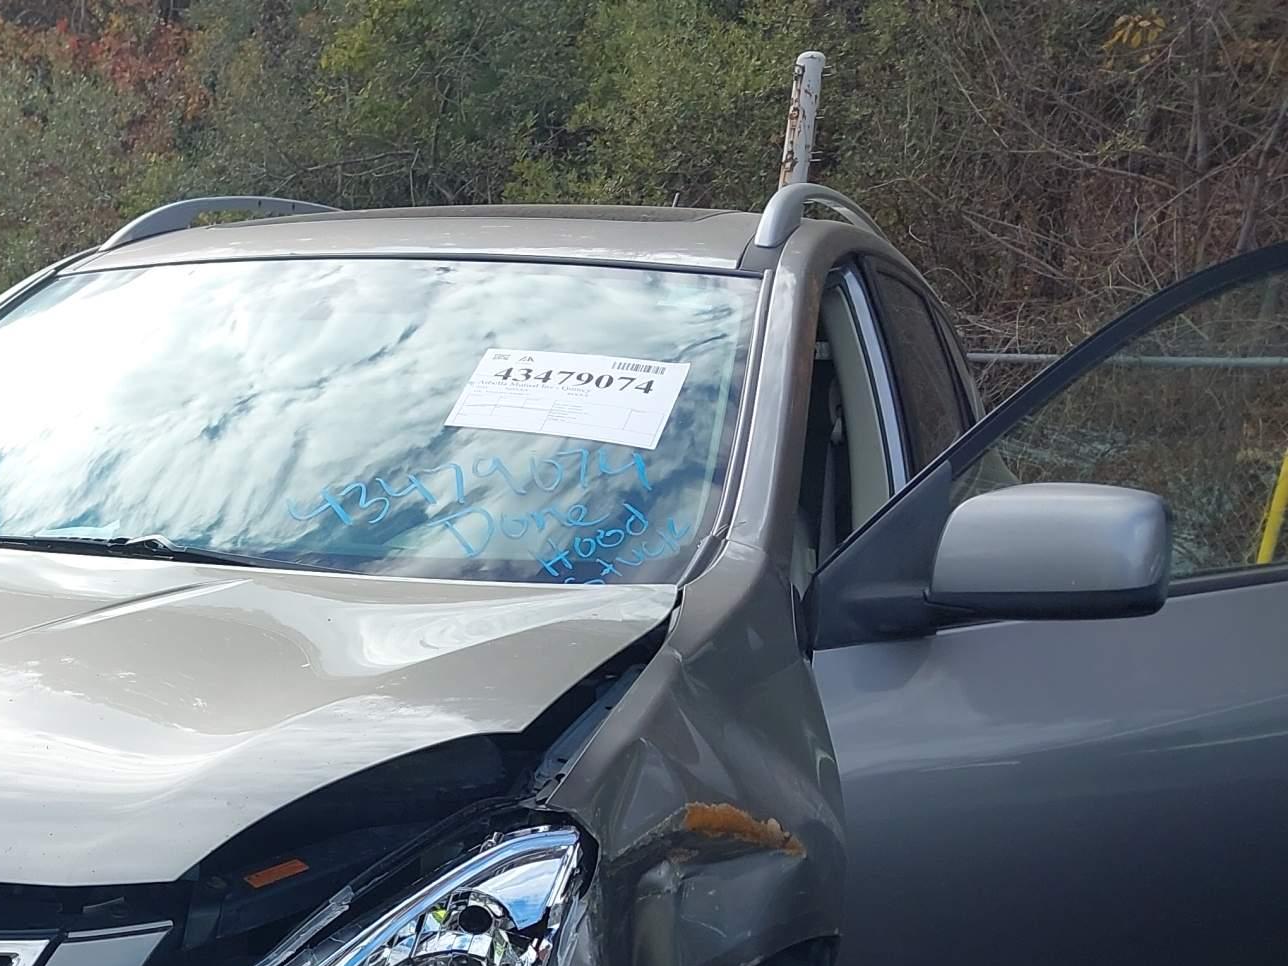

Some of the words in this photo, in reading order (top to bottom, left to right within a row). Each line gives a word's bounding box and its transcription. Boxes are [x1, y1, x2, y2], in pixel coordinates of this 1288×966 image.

[494, 367, 655, 394] 43479074
[288, 448, 652, 526] 43479074
[427, 503, 610, 557] Done
[534, 503, 649, 577] Hood
